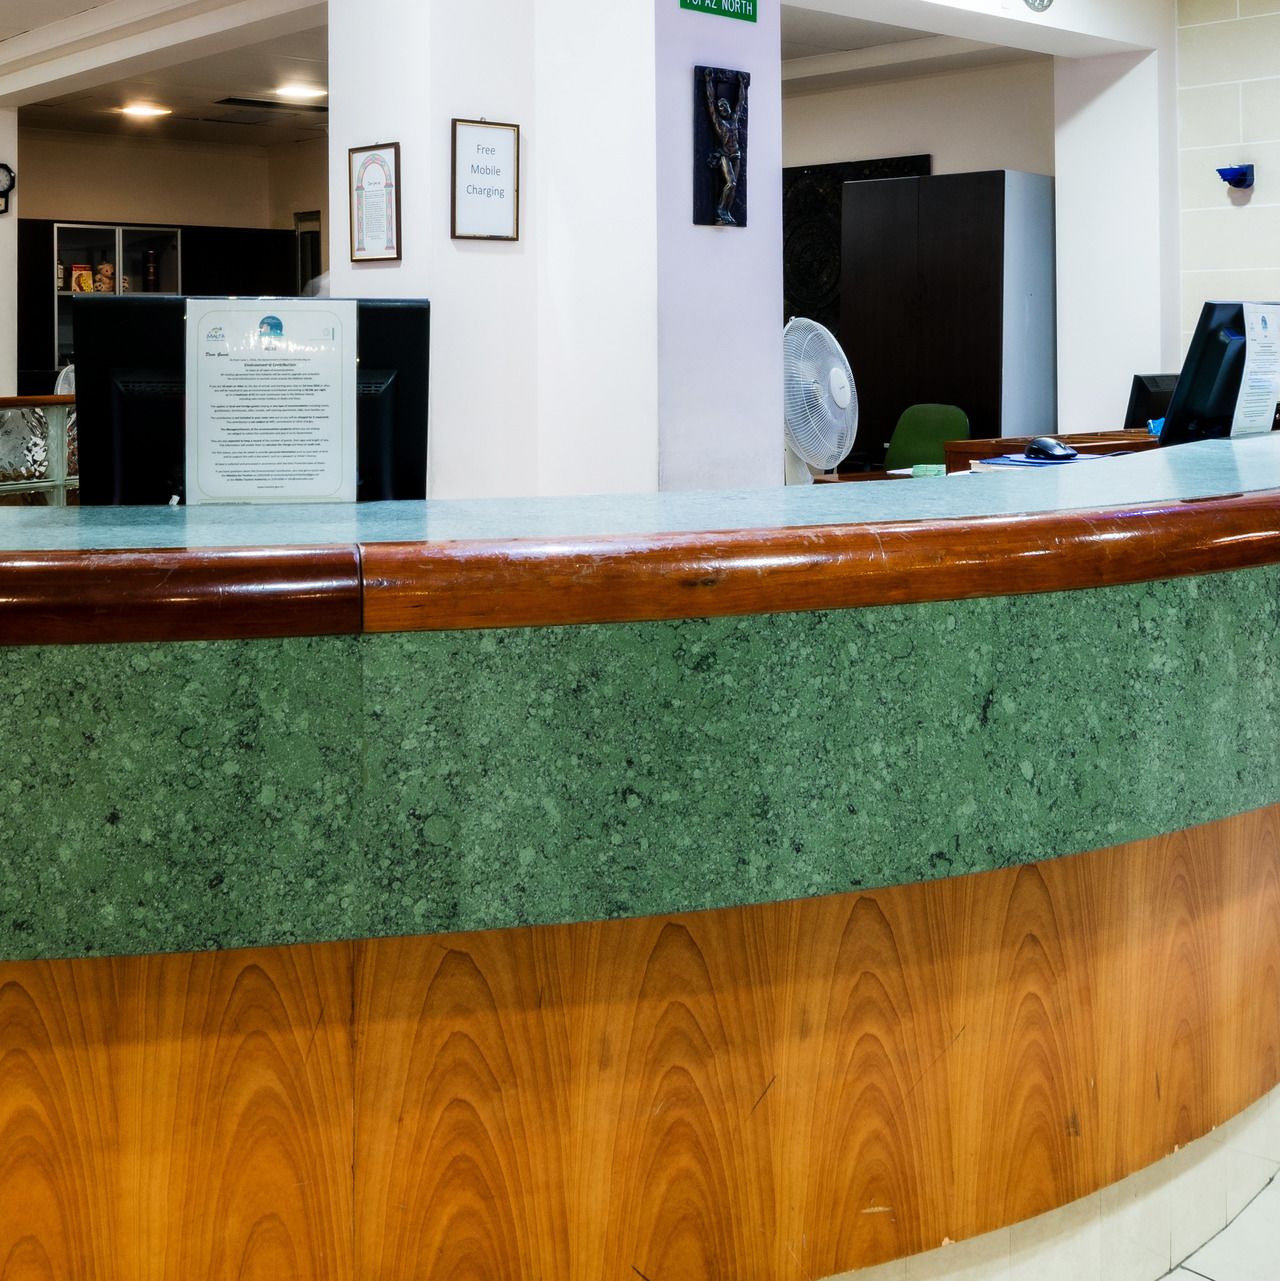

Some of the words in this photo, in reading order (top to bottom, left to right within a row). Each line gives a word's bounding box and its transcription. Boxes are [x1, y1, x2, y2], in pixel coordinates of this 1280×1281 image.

[476, 144, 496, 156] Free
[470, 164, 501, 176] Mobile
[466, 184, 505, 199] Charging
